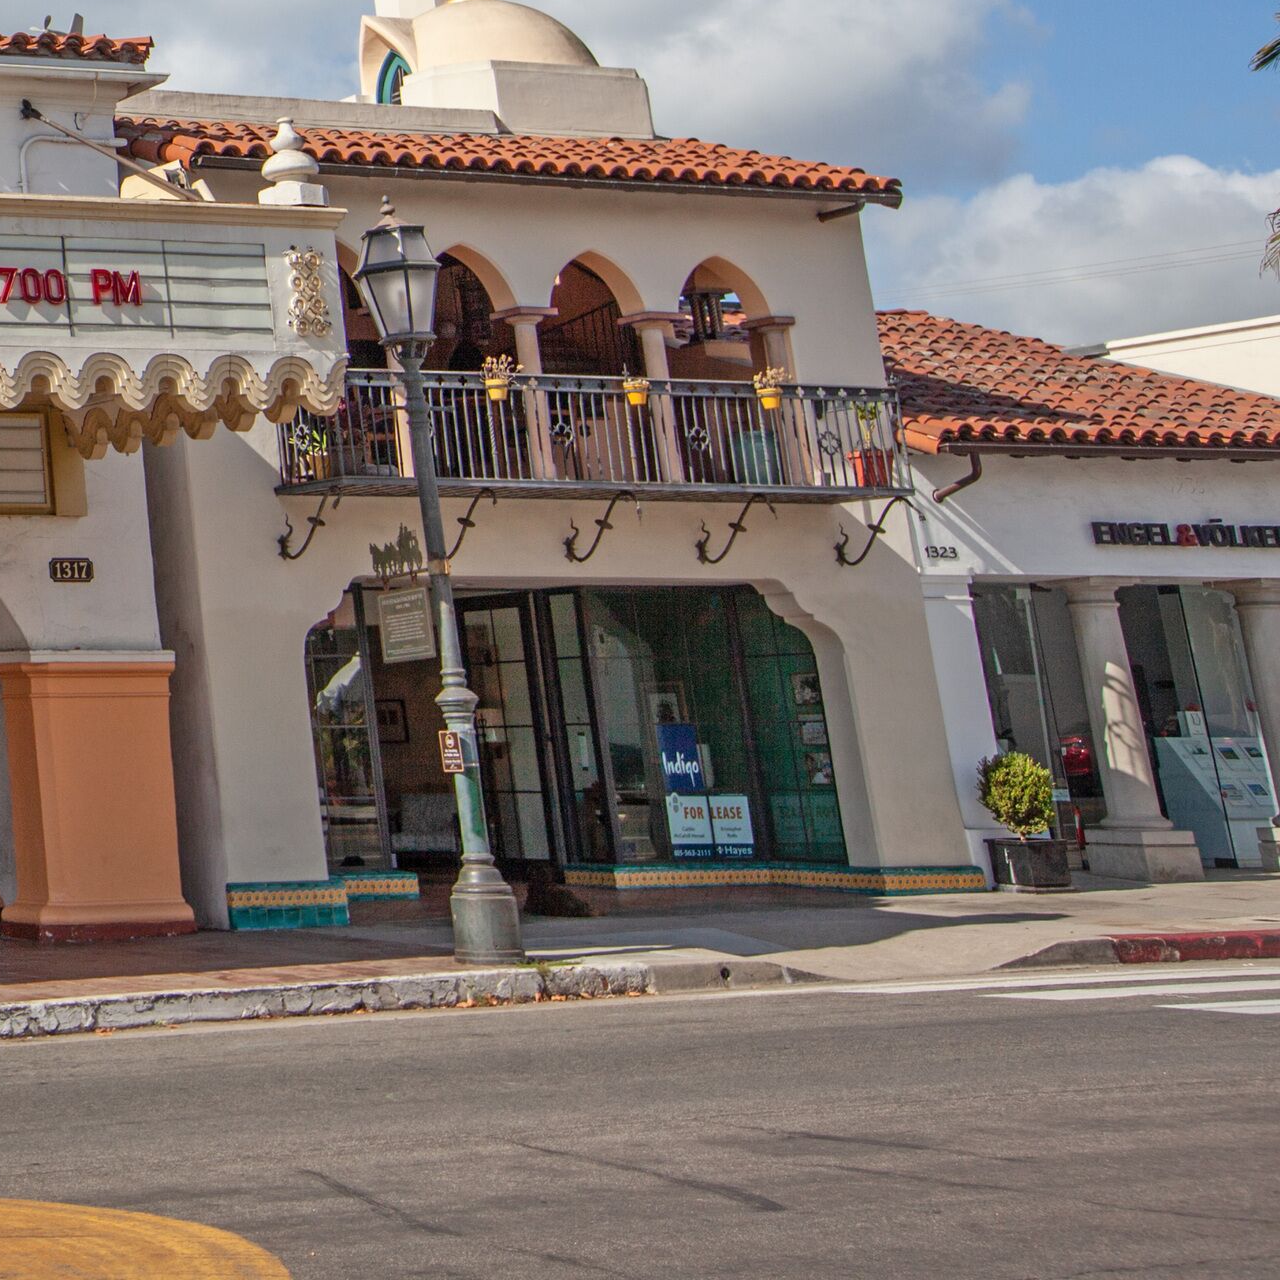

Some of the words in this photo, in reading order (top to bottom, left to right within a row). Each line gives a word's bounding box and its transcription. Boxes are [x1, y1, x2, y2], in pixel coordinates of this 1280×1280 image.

[91, 269, 142, 306] PM
[924, 545, 958, 559] 1323
[54, 561, 88, 579] 1317
[661, 751, 700, 788] Indigo
[683, 806, 705, 820] FOR
[711, 806, 743, 820] LEASE
[724, 846, 753, 856] Hayes
